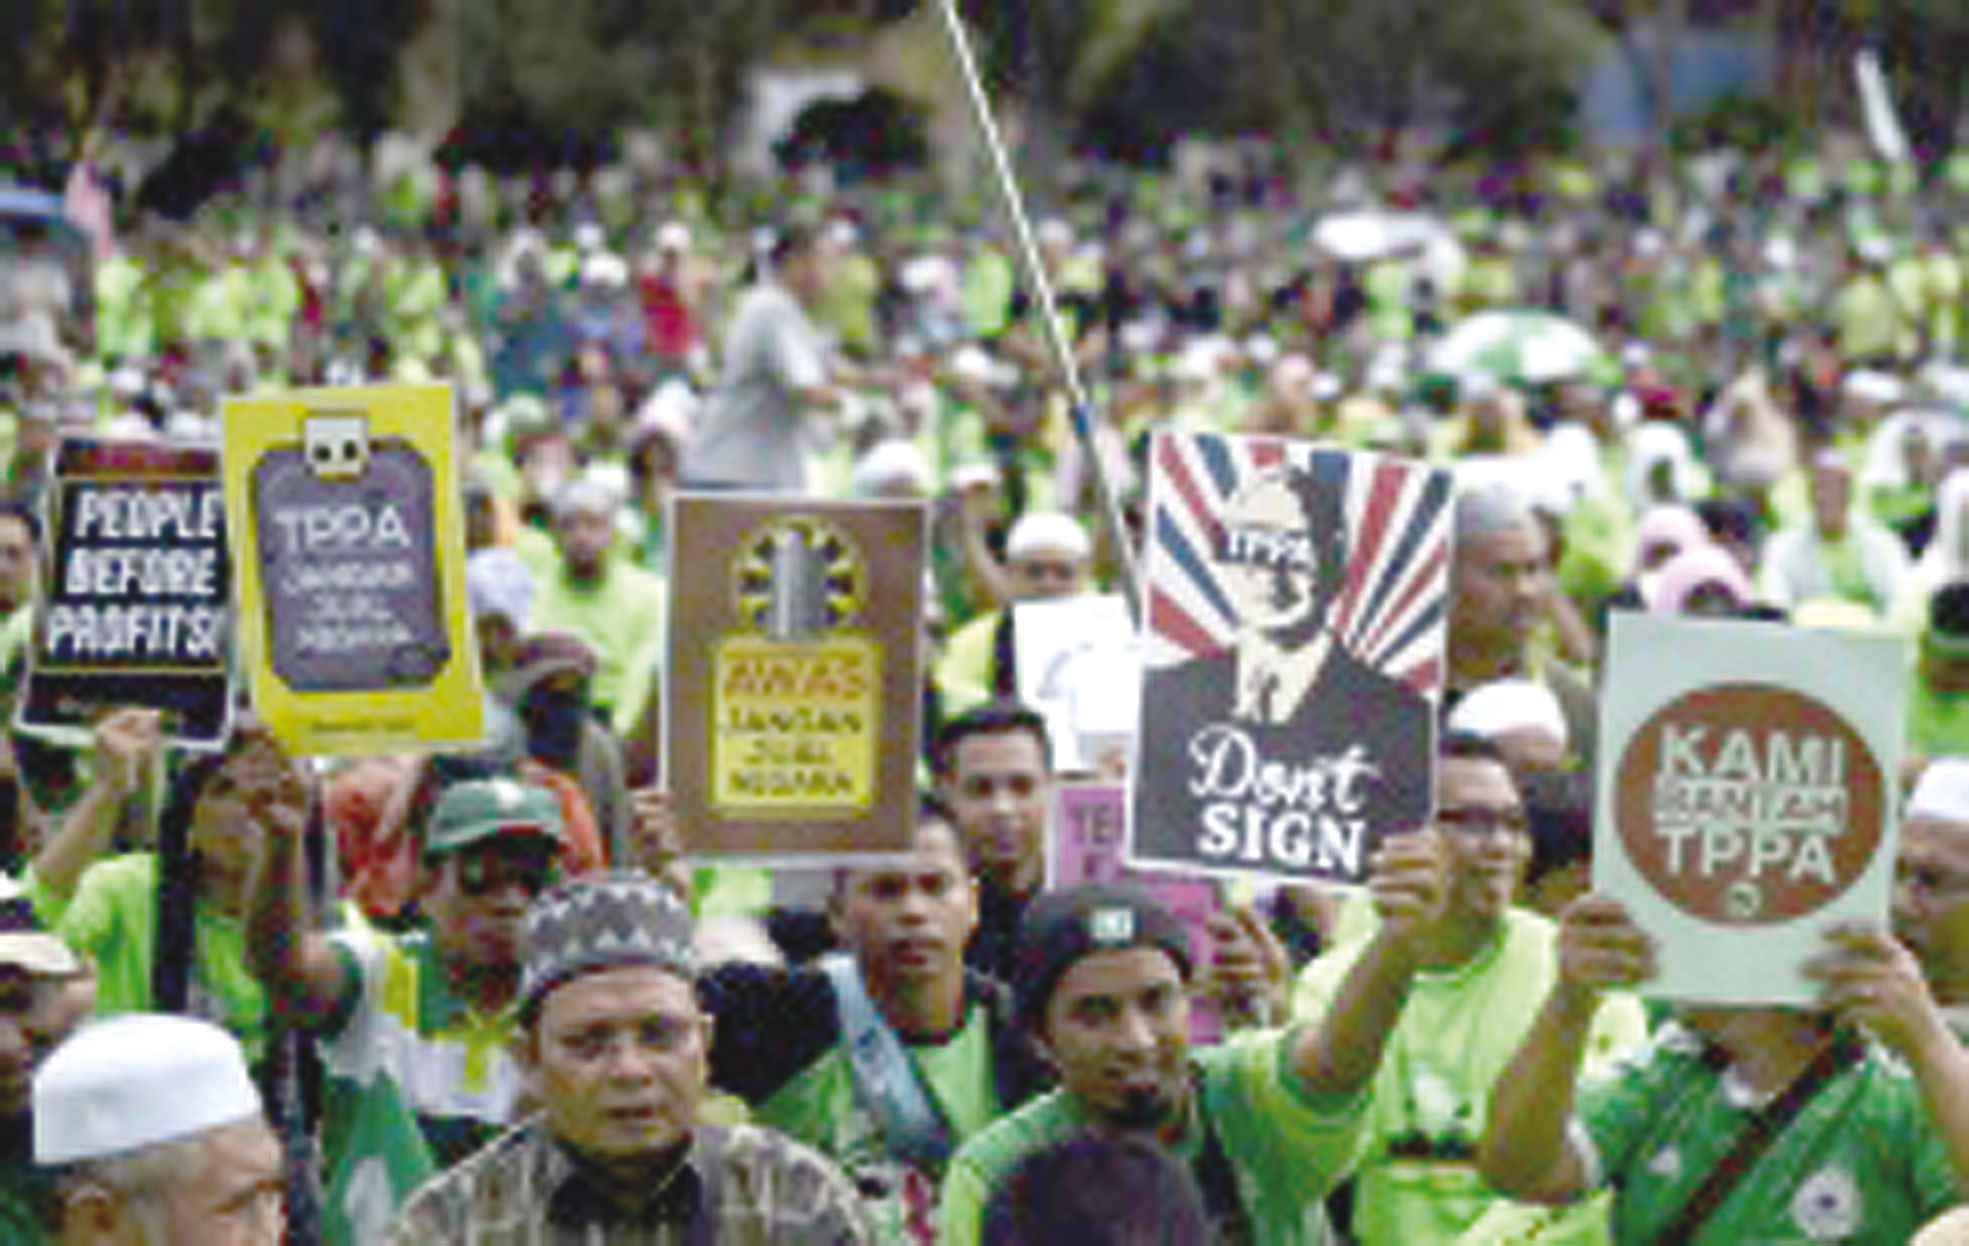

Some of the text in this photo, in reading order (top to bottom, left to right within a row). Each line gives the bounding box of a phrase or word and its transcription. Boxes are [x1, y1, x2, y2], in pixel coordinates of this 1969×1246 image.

[73, 489, 225, 539] PEOPLE
[273, 505, 412, 551] TPPA
[64, 547, 217, 595] BEFORE
[1660, 723, 1845, 785] KAMI
[1197, 800, 1368, 878] SIGN
[1654, 823, 1838, 883] TPPA
